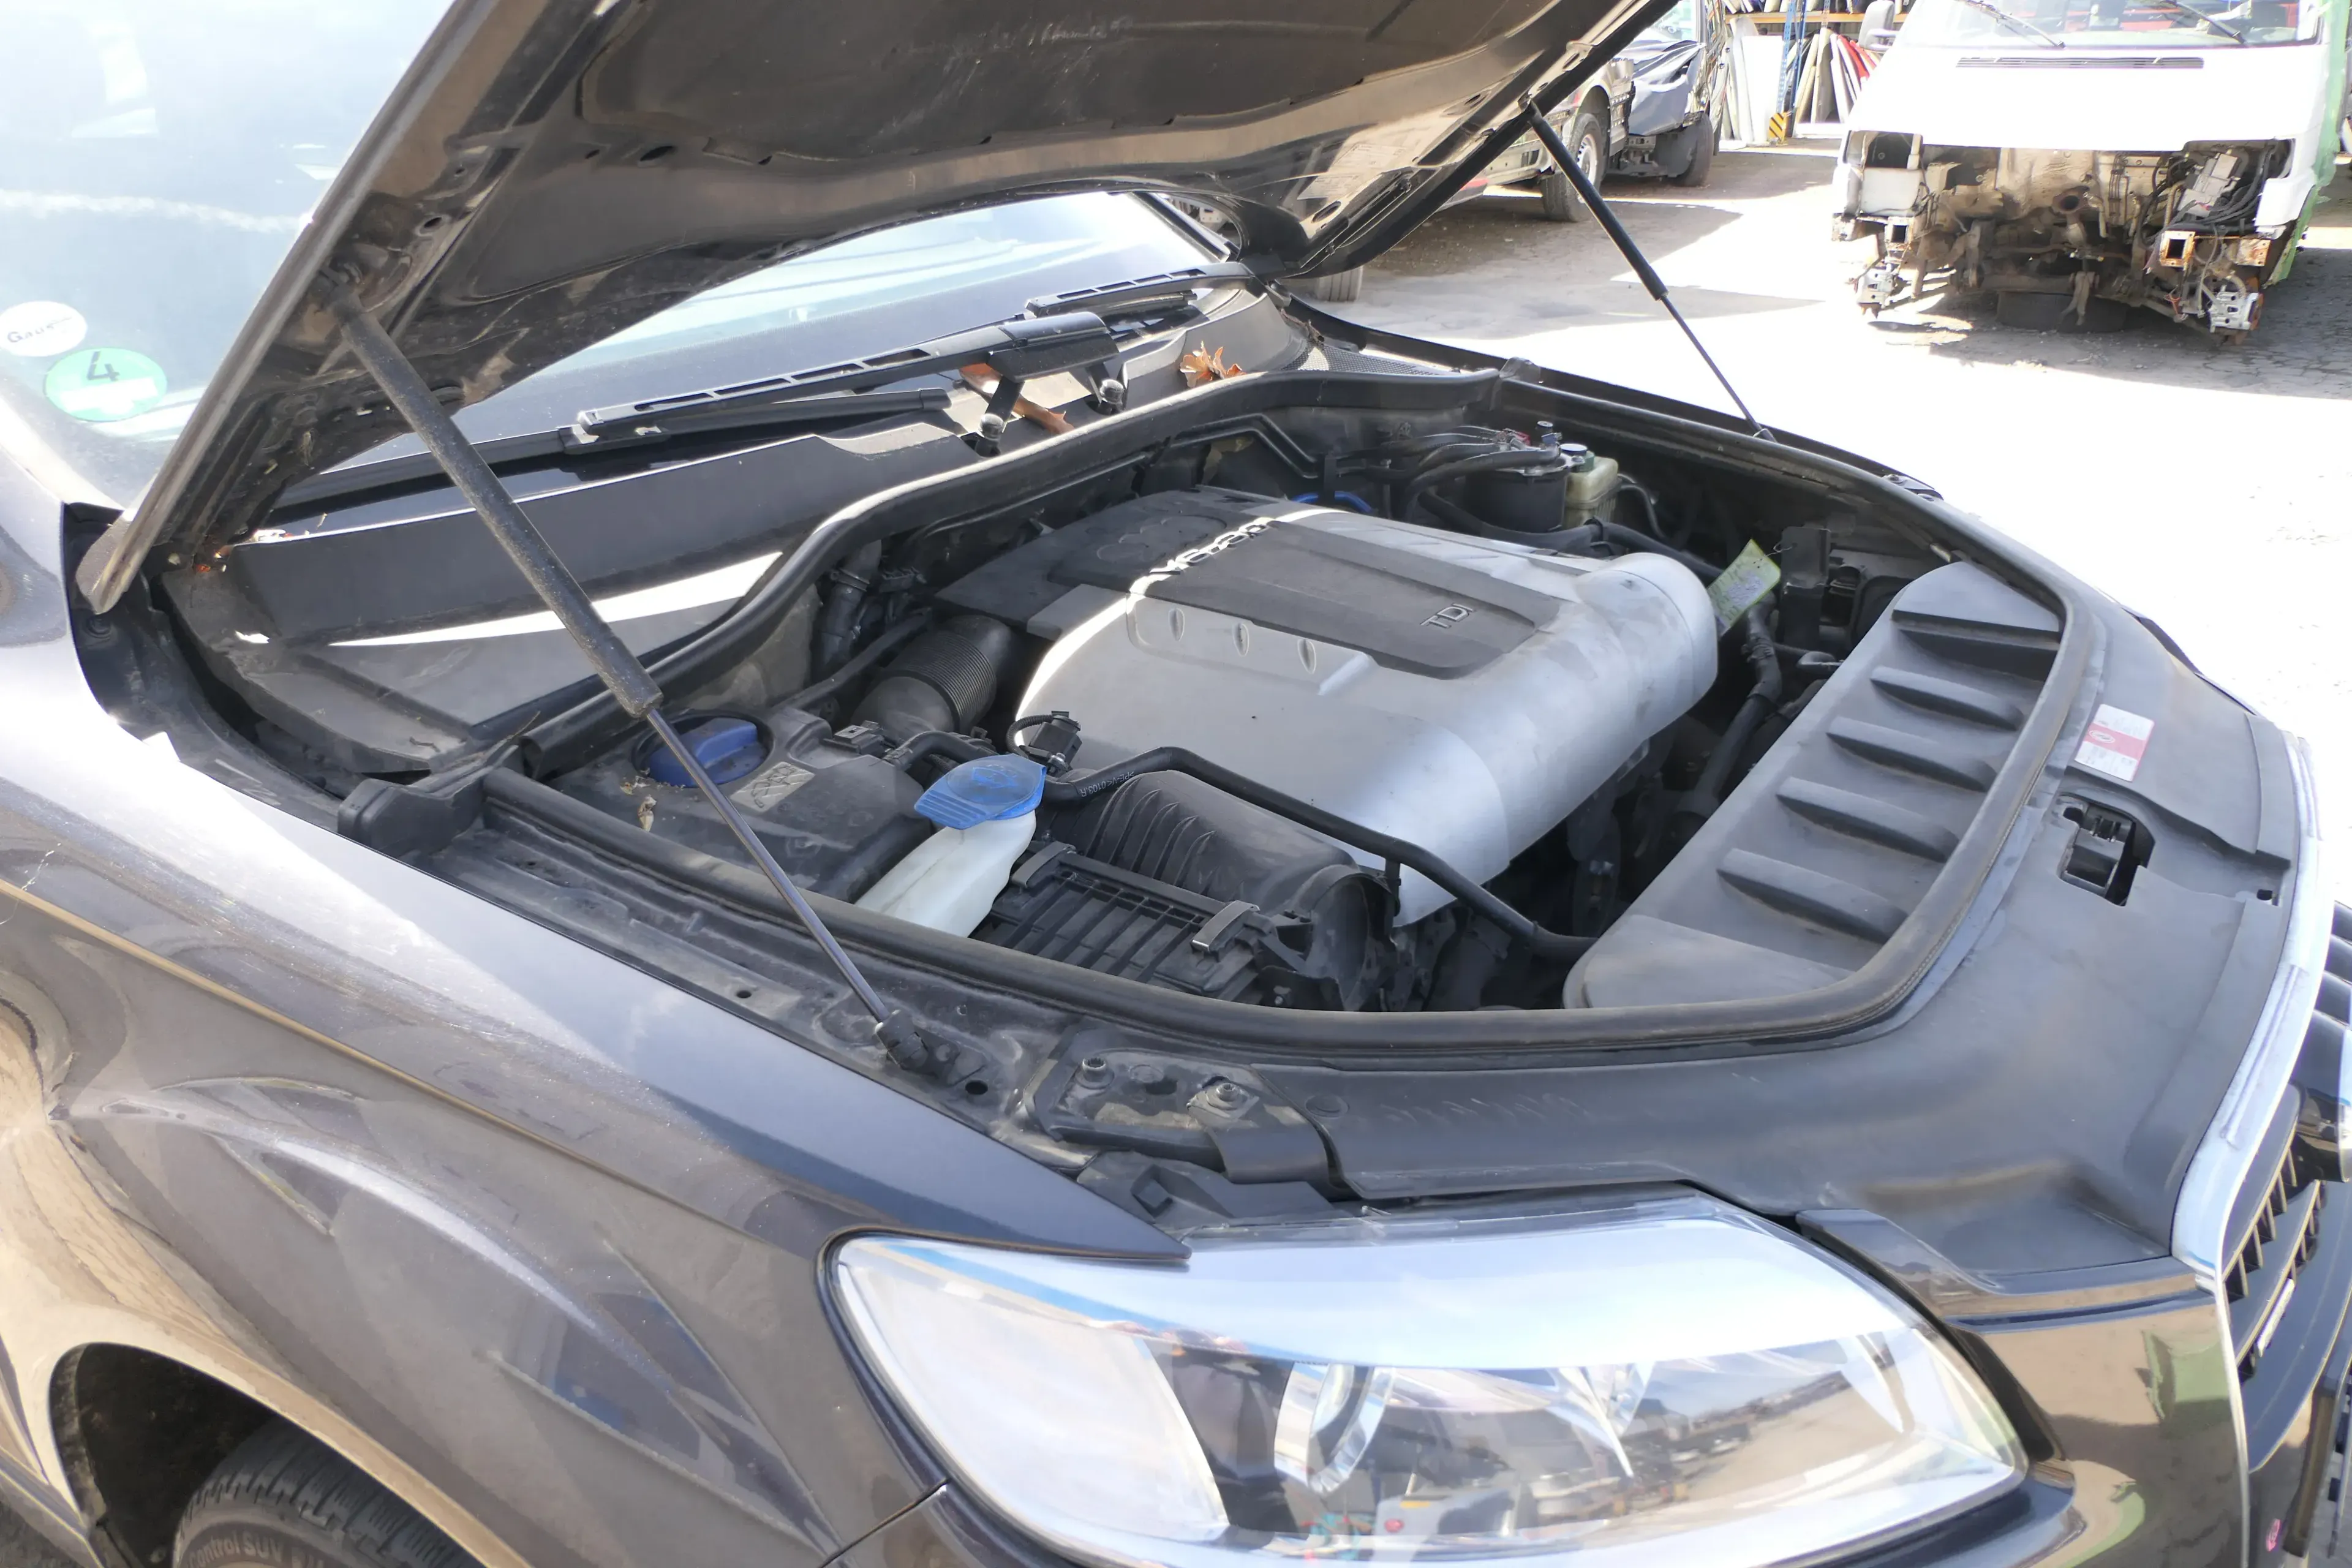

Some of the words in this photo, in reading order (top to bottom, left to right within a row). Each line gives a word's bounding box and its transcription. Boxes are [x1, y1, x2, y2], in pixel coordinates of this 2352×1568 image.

[87, 350, 121, 382] 4
[1420, 603, 1475, 628] TDI
[243, 1532, 285, 1562] SUV
